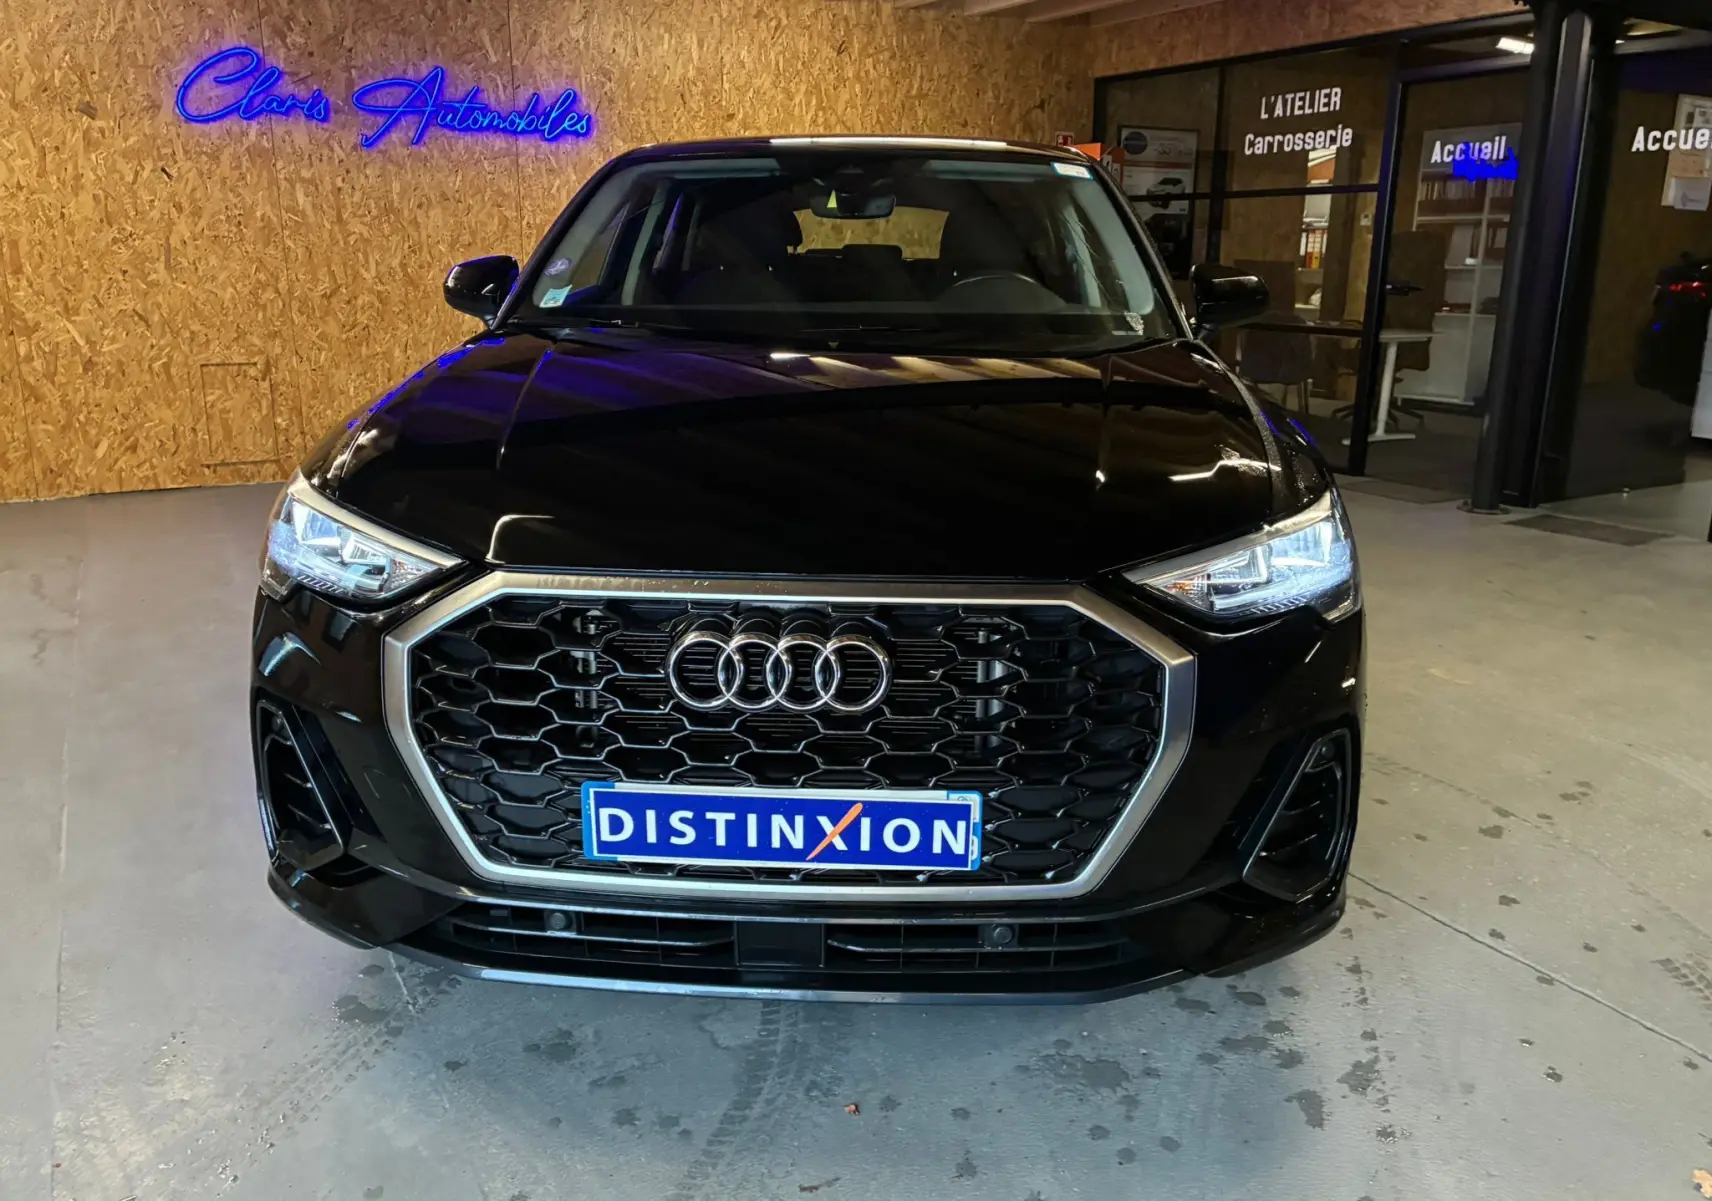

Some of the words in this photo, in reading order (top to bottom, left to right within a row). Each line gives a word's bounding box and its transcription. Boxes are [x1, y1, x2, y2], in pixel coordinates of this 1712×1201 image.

[176, 46, 331, 123] Claris
[352, 66, 593, 149] Automobiles
[1260, 87, 1342, 119] L'ATELIER
[1244, 124, 1353, 155] Carrosserie
[1430, 136, 1507, 164] Accueil
[1631, 126, 1712, 152] Accue
[599, 802, 967, 861] DISTINXION
